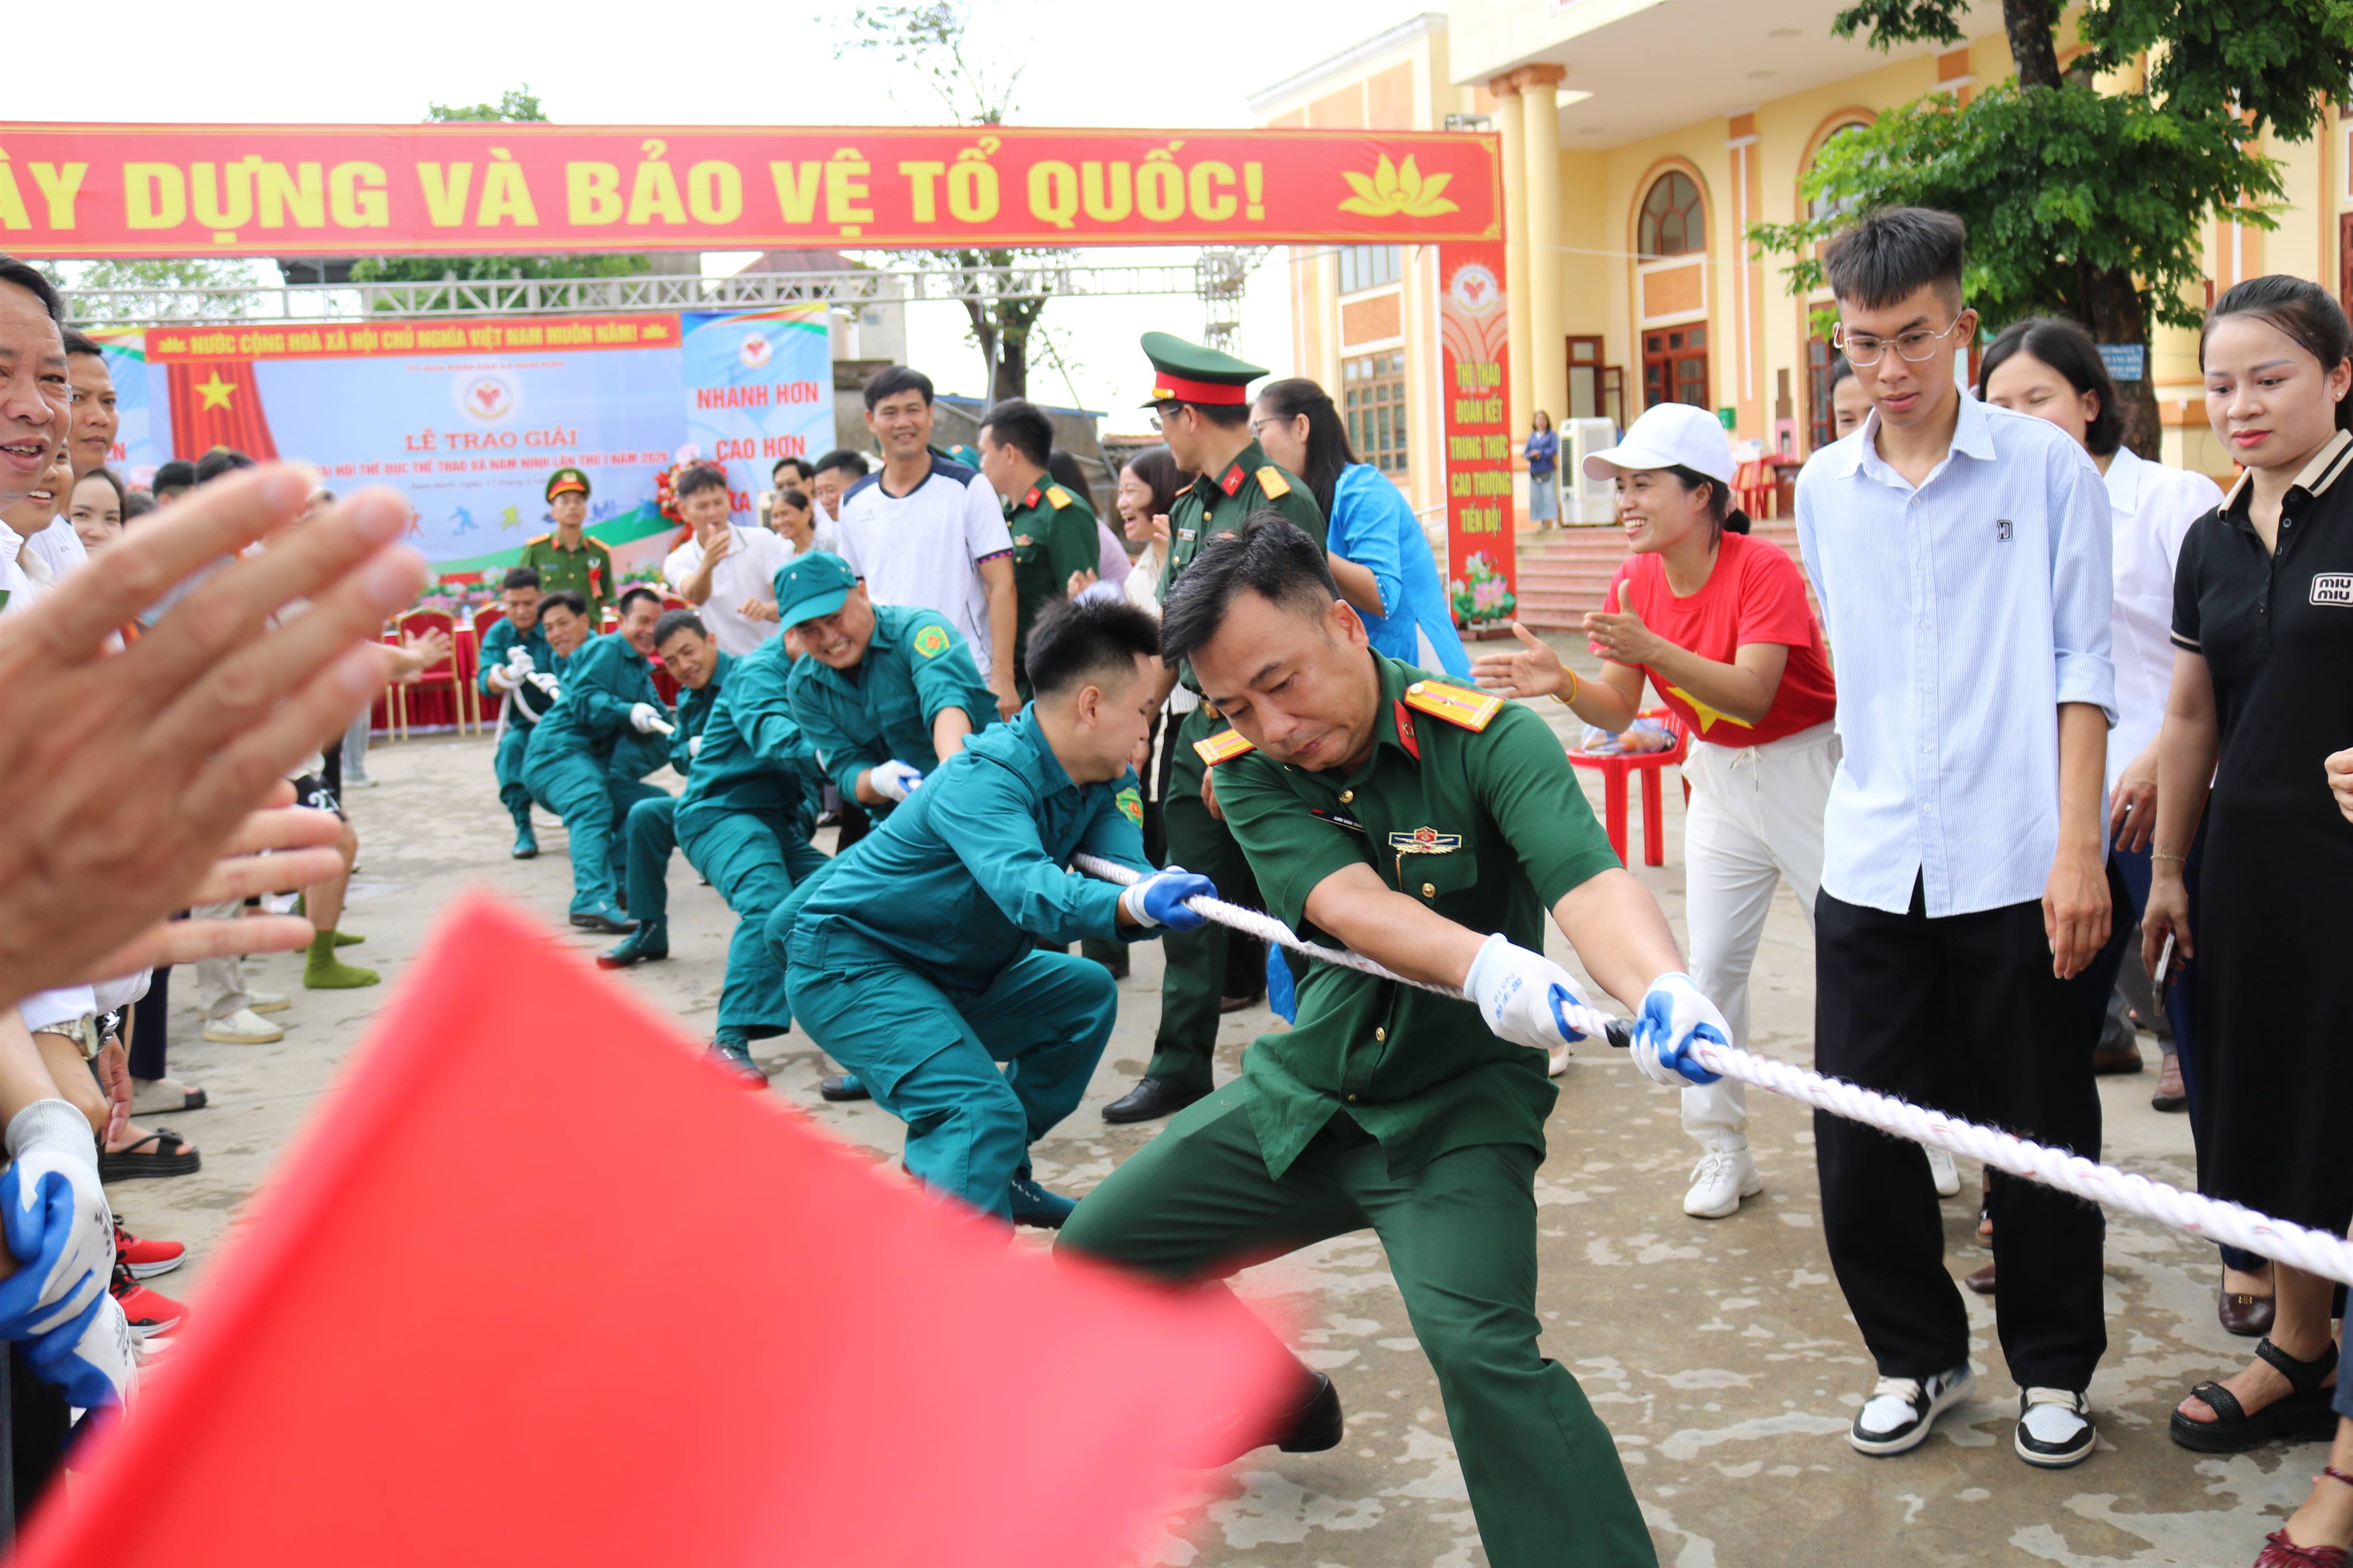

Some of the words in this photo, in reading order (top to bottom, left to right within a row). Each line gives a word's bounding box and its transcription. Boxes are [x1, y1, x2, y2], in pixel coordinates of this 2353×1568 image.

[123, 155, 391, 244] DỰNG
[416, 148, 539, 227] VÀ
[566, 139, 743, 226] BẢO
[770, 147, 874, 237] VỆ
[898, 136, 1001, 223] TỔ
[1027, 140, 1265, 229] QUỐC!
[190, 333, 236, 354] NƯỚC
[240, 331, 285, 357] CỘNG
[325, 329, 349, 352] XÃ
[350, 329, 379, 354] HỘI
[382, 326, 414, 350] CHỦ
[418, 326, 468, 348] NGHĨA
[469, 325, 503, 350] VIỆT
[506, 327, 543, 346] NAM
[546, 322, 593, 345] MUÔN
[595, 321, 638, 343] NĂM!
[1455, 354, 1474, 387] THỂ
[1476, 362, 1500, 387] THAO
[696, 384, 769, 410] NHANH
[777, 380, 819, 404] HƠN
[1455, 394, 1483, 424] ĐOÀN
[1484, 391, 1503, 424] KẾT
[405, 426, 438, 451] LỄ
[443, 430, 518, 450] TRAO
[523, 424, 578, 447] GIẢI
[716, 437, 755, 461] CAO
[763, 434, 805, 458] HƠN
[1449, 435, 1482, 460] TRUNG
[1484, 433, 1509, 464] THỰC
[438, 459, 466, 473] THAO
[491, 457, 516, 470] NAM
[521, 455, 549, 469] NINH
[1451, 472, 1471, 497] CAO
[1473, 469, 1512, 501] THƯỢNG
[1460, 501, 1483, 534] TIẾN
